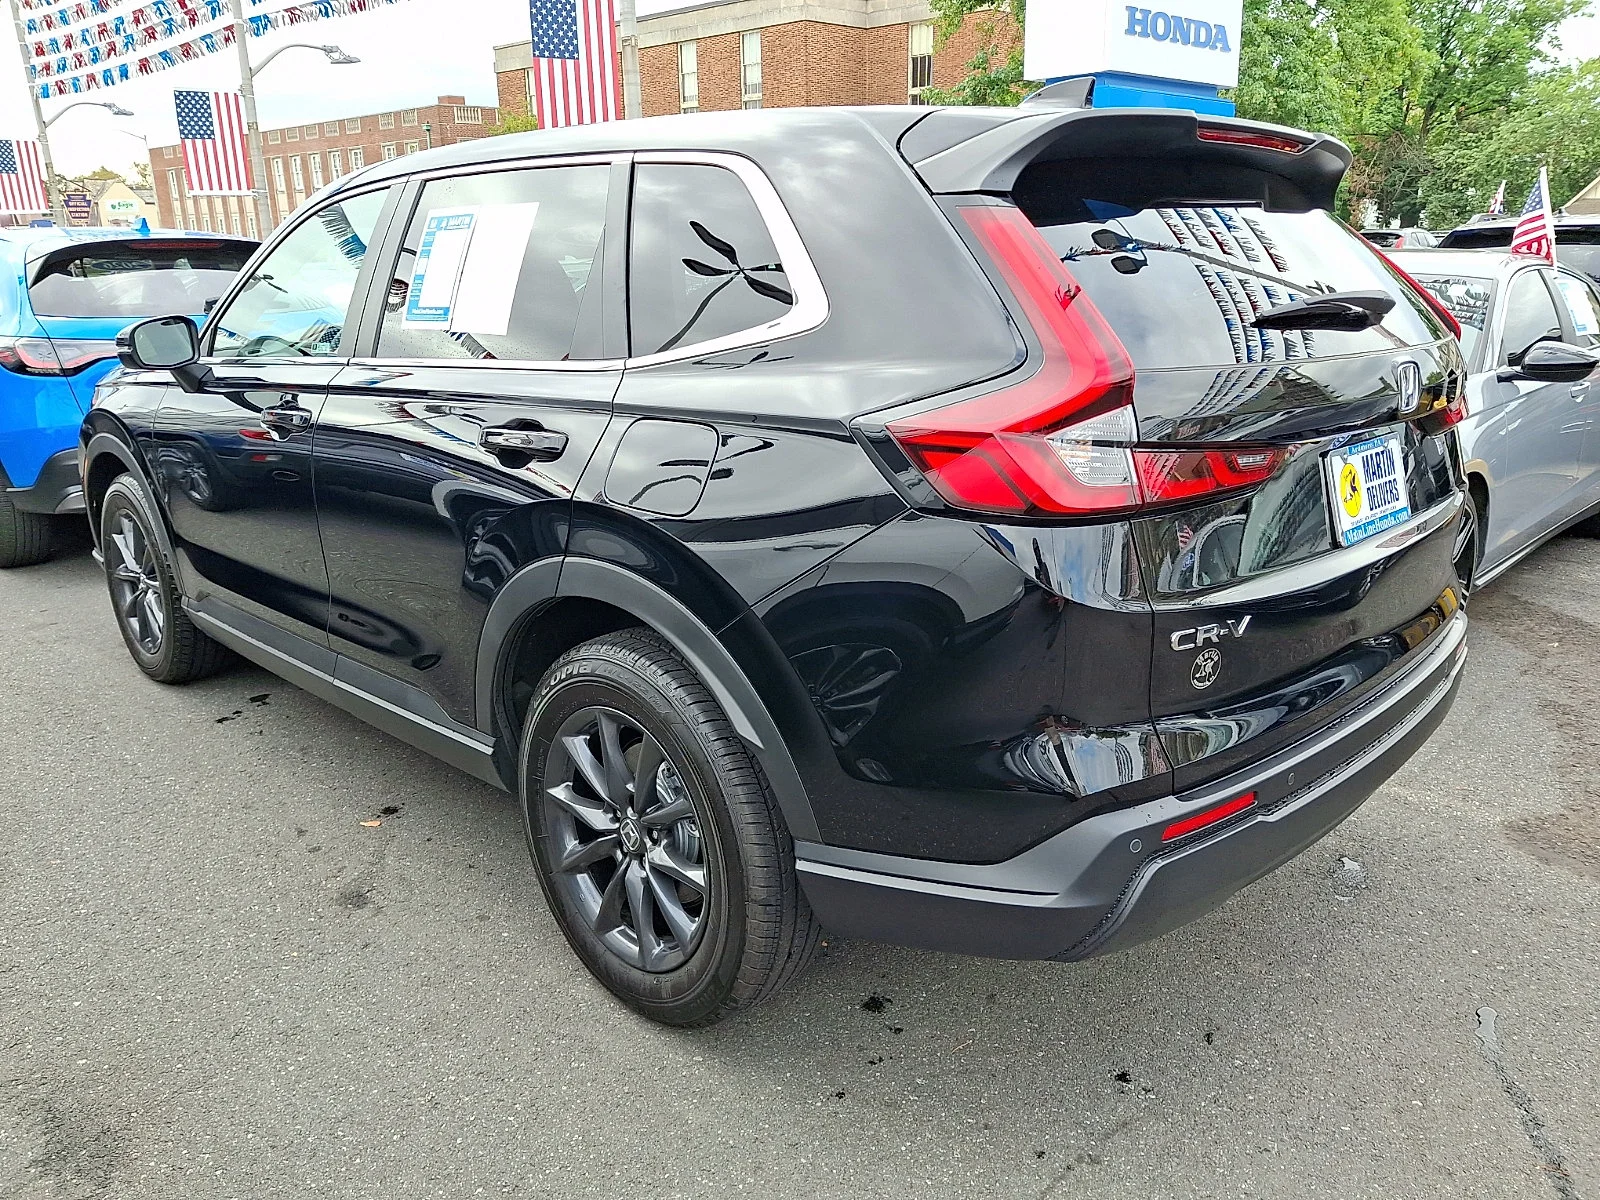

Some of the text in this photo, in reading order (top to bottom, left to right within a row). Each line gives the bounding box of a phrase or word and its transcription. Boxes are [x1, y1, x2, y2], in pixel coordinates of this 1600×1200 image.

[1125, 6, 1232, 53] HONDA
[1361, 447, 1396, 484] MARTIN
[1366, 478, 1399, 511] DELIVERS
[1346, 510, 1408, 545] MainLineHonda.com
[1170, 615, 1253, 651] CR-V
